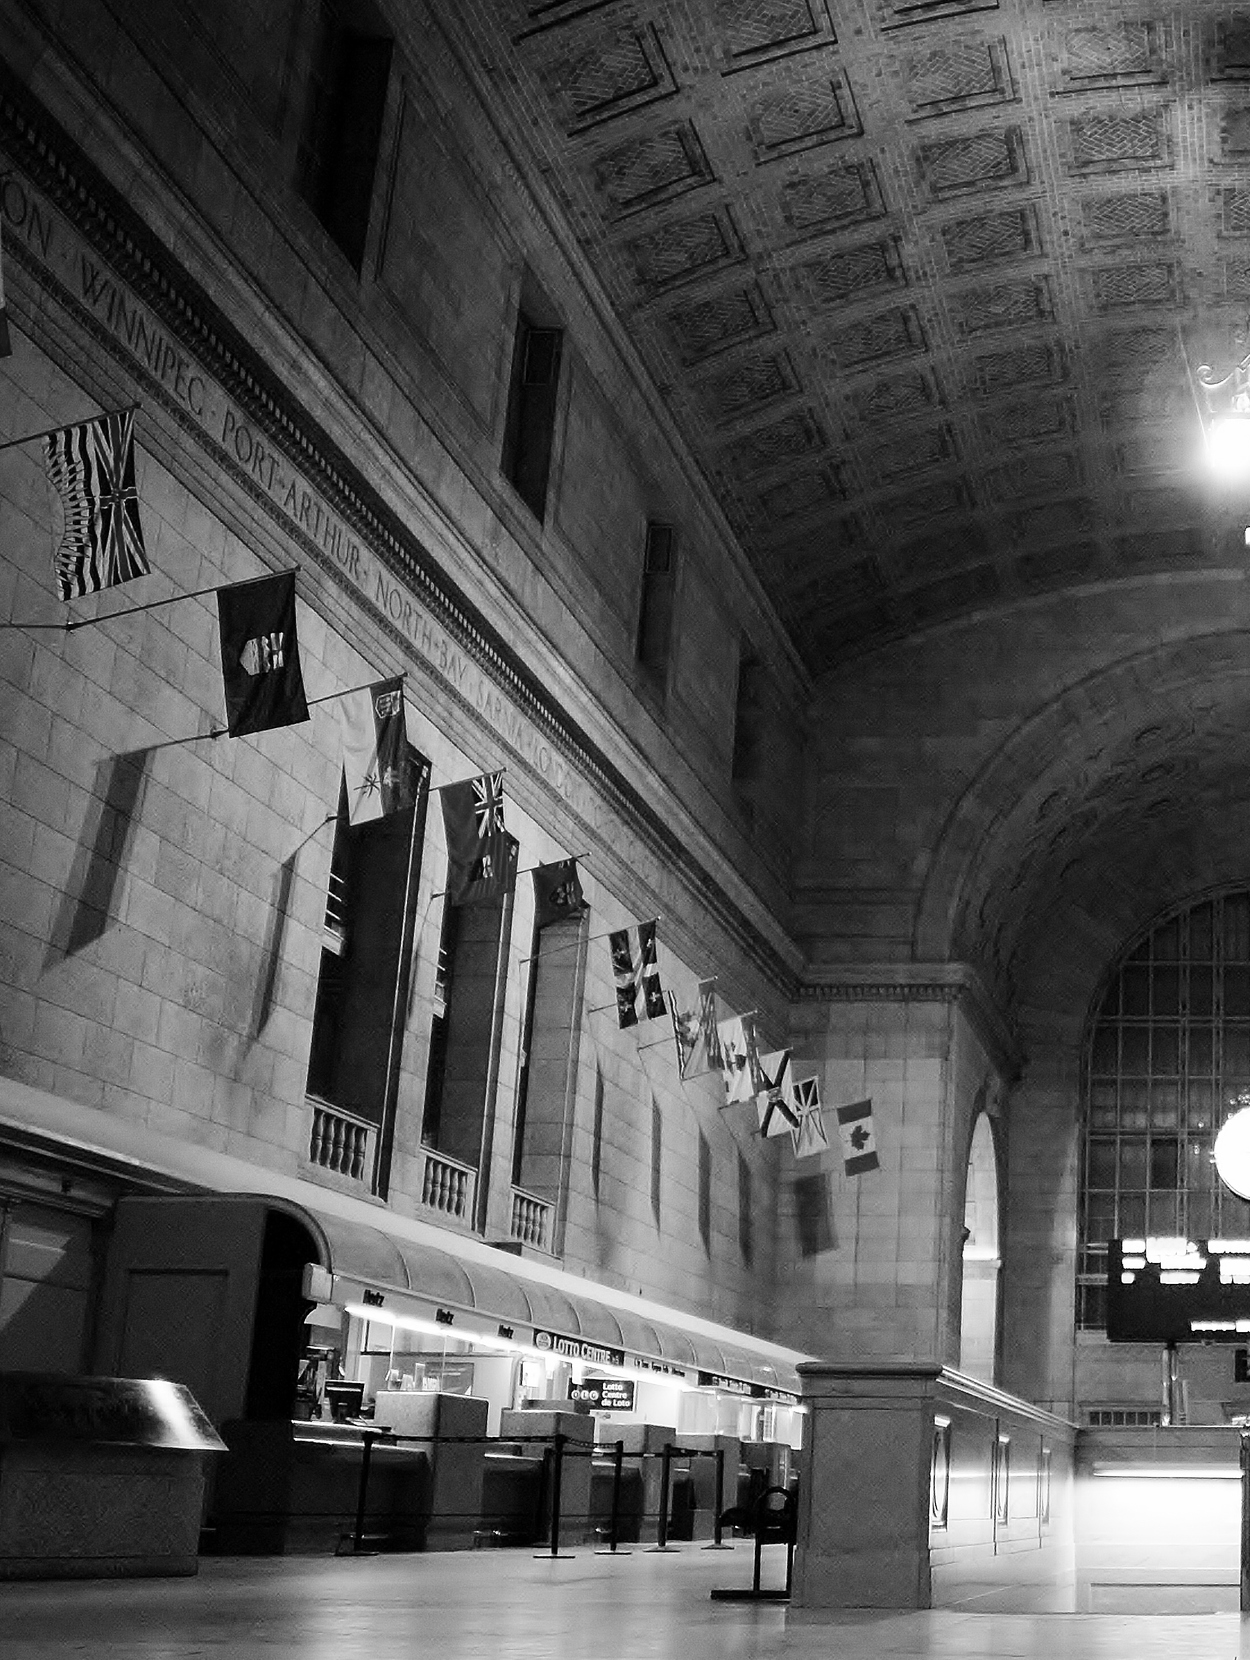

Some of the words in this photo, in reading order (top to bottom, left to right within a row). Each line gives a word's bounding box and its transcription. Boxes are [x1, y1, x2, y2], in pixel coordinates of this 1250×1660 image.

[222, 404, 280, 491] PORT
[284, 479, 361, 579] ARTHUR
[375, 577, 435, 650] NORTH
[437, 637, 467, 684] BAY
[553, 1336, 580, 1357] LOTTO
[581, 1344, 611, 1364] CENTRE
[602, 1382, 623, 1391] Lotto
[602, 1391, 627, 1399] Centre
[601, 1398, 612, 1406] de
[613, 1399, 630, 1407] Loto
